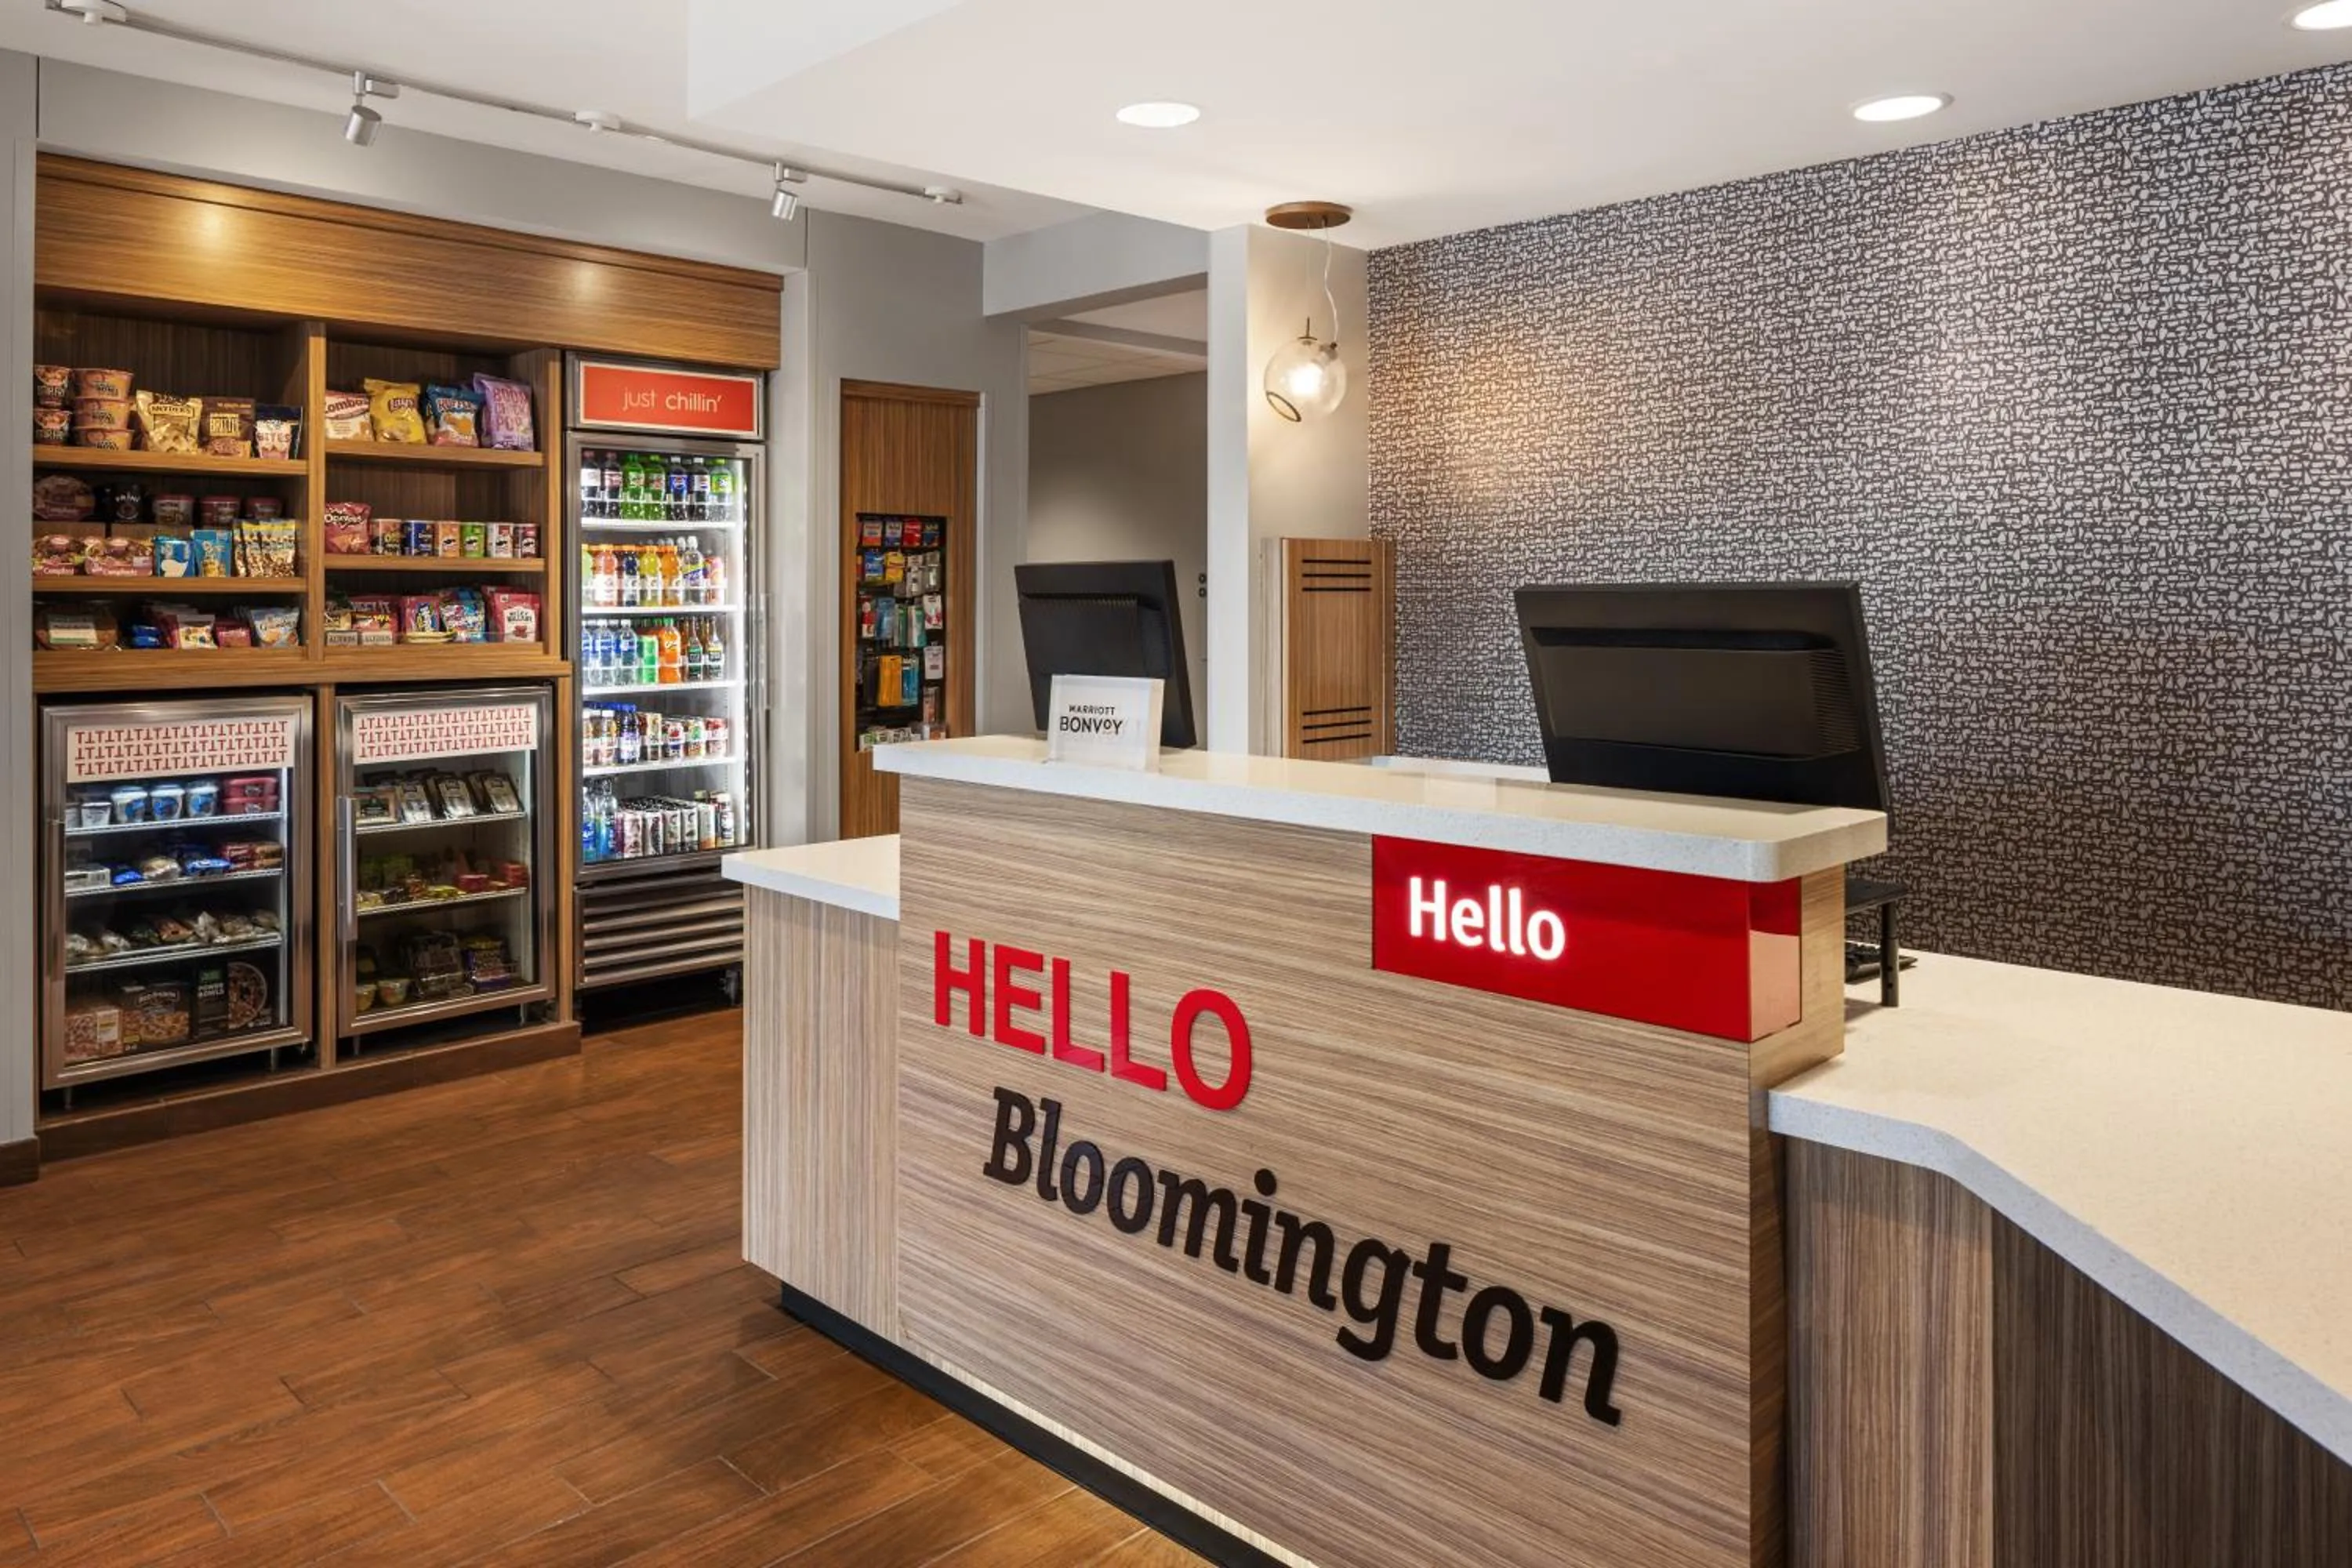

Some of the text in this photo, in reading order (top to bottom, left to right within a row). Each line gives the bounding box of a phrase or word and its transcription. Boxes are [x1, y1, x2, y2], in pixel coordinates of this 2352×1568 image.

[622, 387, 721, 413] just chillin'
[1069, 705, 1116, 715] MARRIOTT
[1407, 873, 1568, 963] Hello
[933, 927, 1254, 1112] HELLO
[983, 1087, 1622, 1428] Bloomington
